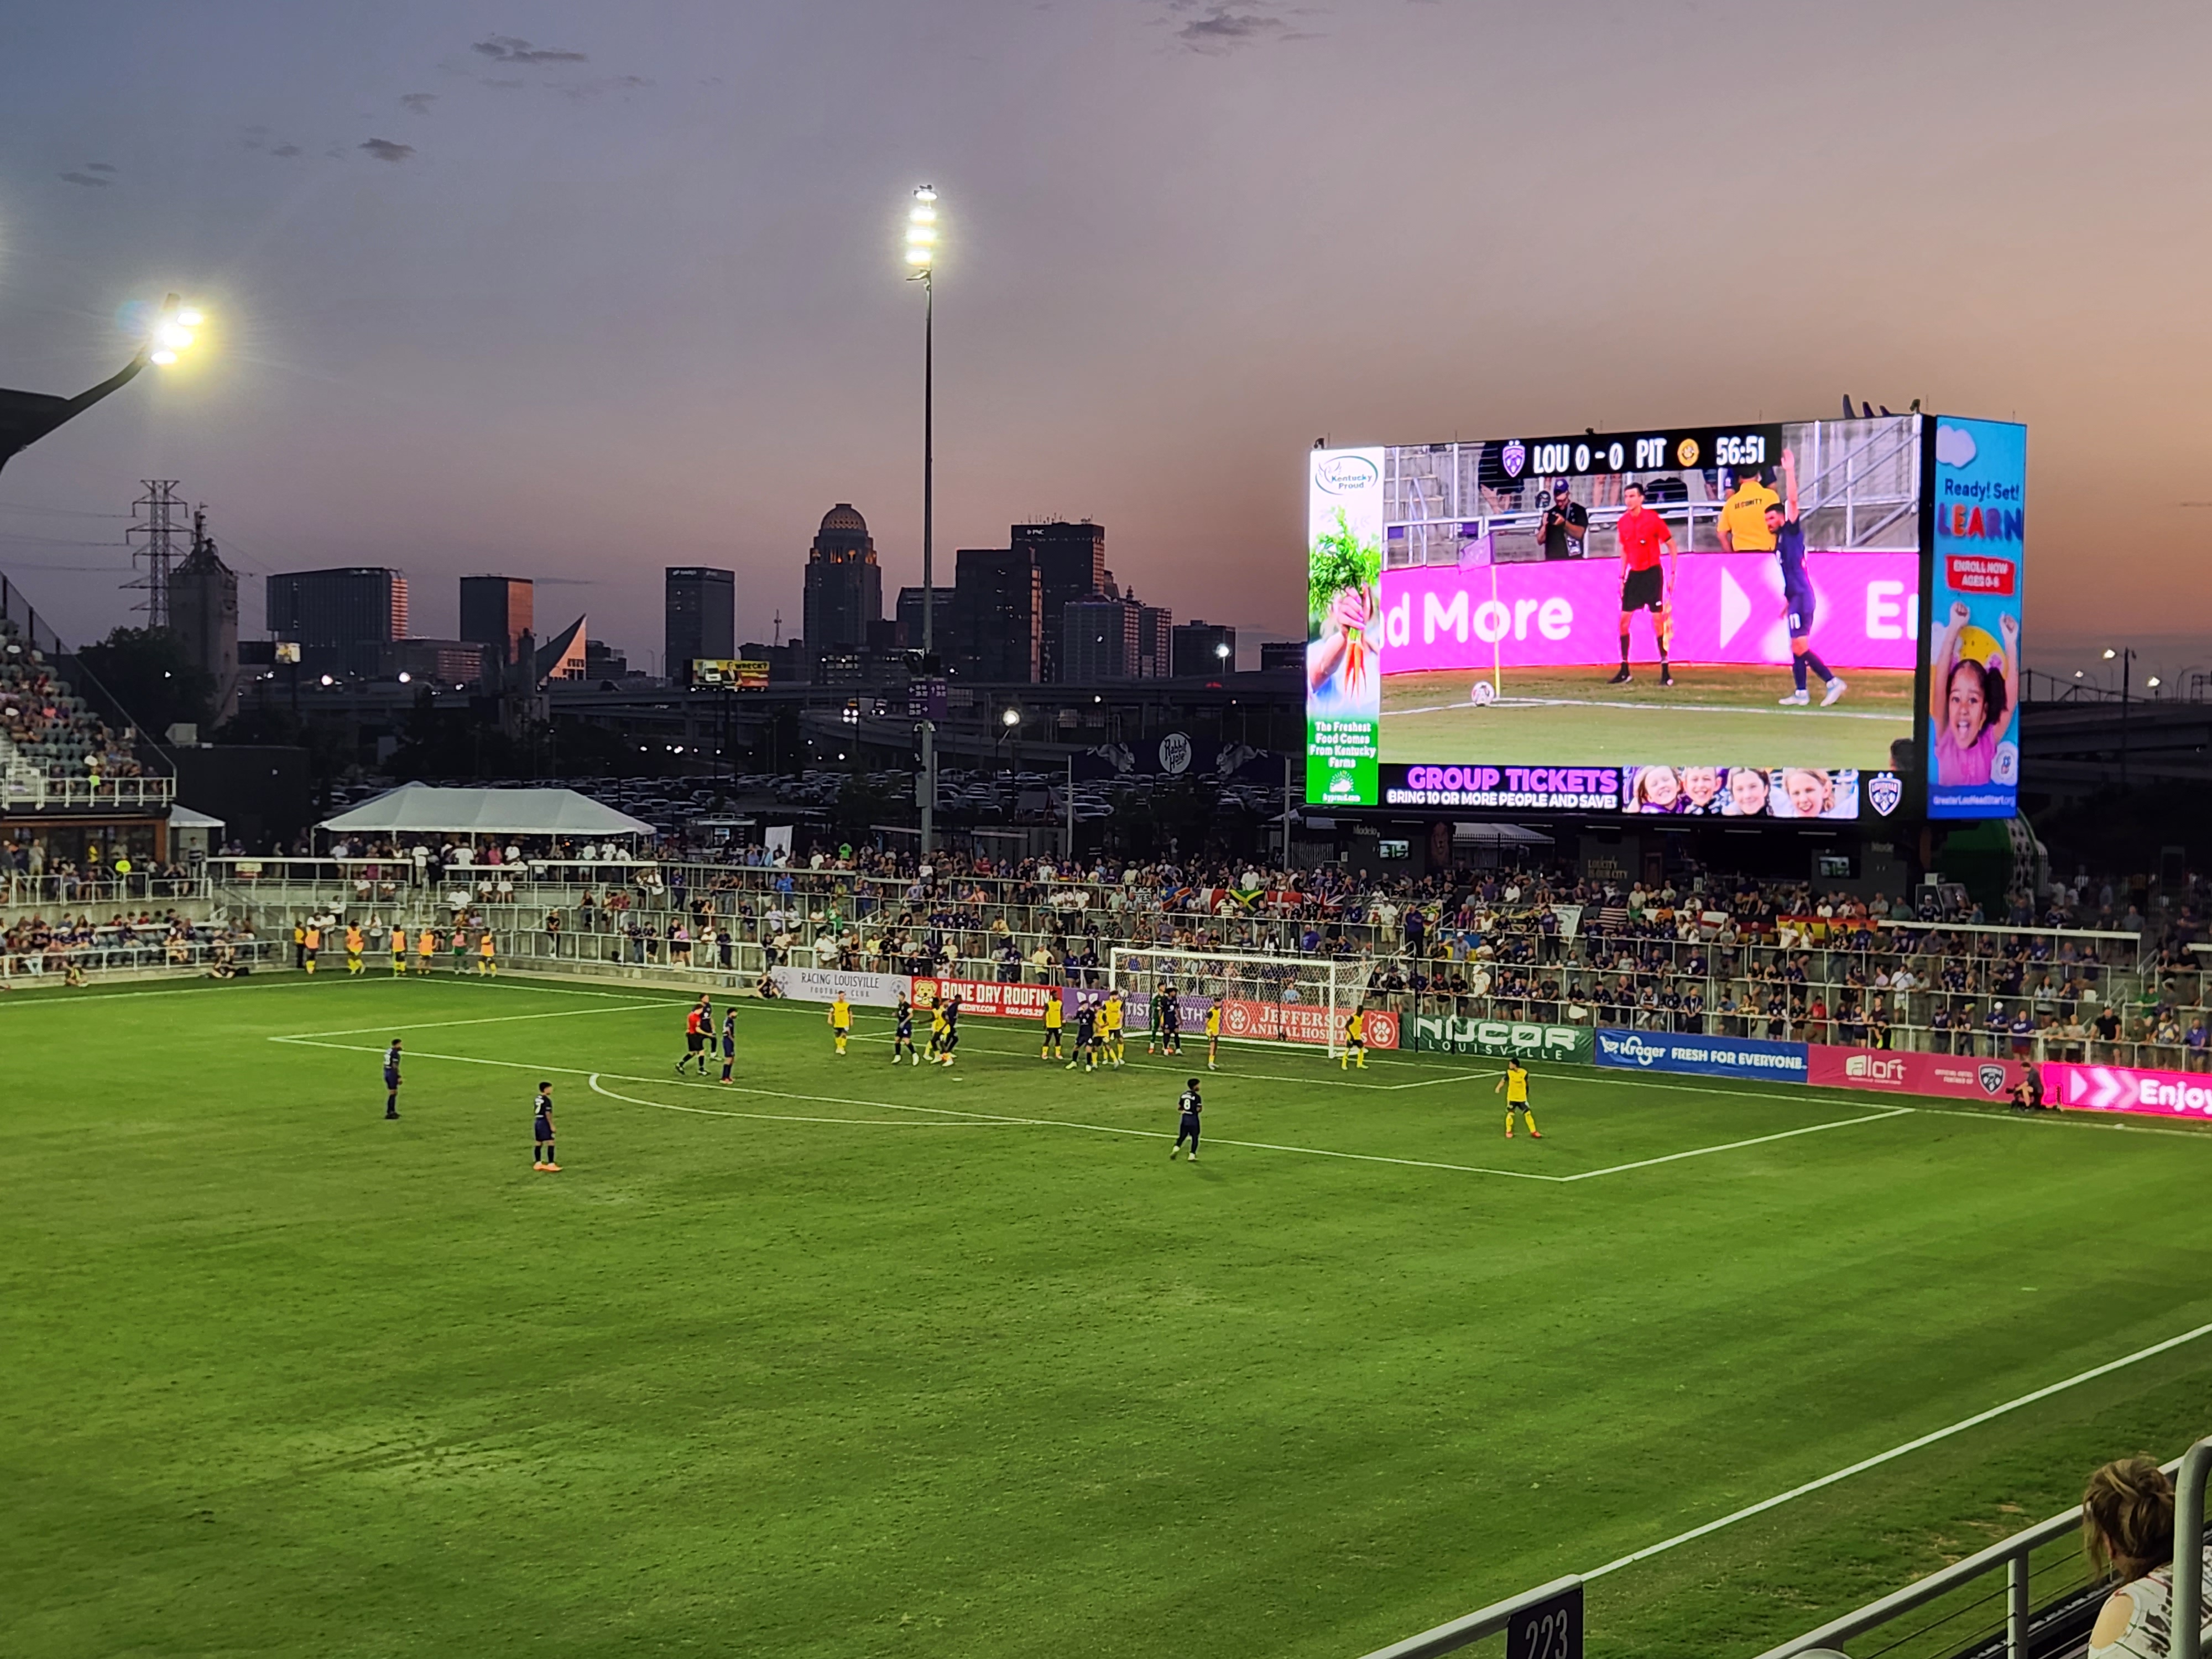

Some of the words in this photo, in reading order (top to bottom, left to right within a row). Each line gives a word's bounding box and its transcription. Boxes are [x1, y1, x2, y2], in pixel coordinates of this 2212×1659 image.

[1533, 444, 1570, 473] LOU
[1636, 437, 1667, 468] PIT
[1716, 436, 1765, 465] 56:51
[1332, 474, 1372, 482] Kentucky
[1944, 478, 1991, 502] Ready!
[1993, 482, 2020, 502] Set!
[1937, 502, 2023, 541] LEARN
[1424, 590, 1573, 644] More
[1315, 721, 1332, 732] The
[1333, 721, 1371, 732] Freshest
[1315, 733, 1338, 744] Food
[1340, 733, 1370, 744] Comes
[1164, 739, 1187, 761] Rabbit
[1310, 744, 1333, 755] From
[1334, 745, 1376, 759] Kentucky
[1170, 753, 1185, 772] Hole
[1328, 757, 1356, 768] Farms
[1407, 767, 1500, 790] GROUP
[1505, 769, 1618, 793] TICKETS
[1387, 789, 1425, 804] BRING
[1426, 791, 1439, 804] 10
[1441, 791, 1459, 805] OR
[1461, 792, 1498, 806] MORE
[1499, 792, 1548, 807] PEOPLE
[1549, 794, 1578, 808] AND
[1579, 794, 1618, 809] SAVE!
[801, 972, 831, 985] RACING
[834, 974, 879, 989] LOUISVILLE
[941, 982, 975, 1001] BONE
[977, 984, 1001, 1004] DRY
[1004, 985, 1053, 1006] ROOFIN
[1125, 1003, 1151, 1017] TIST
[1260, 1006, 1348, 1029] JEFFERSO
[1413, 1017, 1576, 1051] NUCOR
[1428, 1040, 1563, 1060] LOUISVILLE
[1620, 1036, 1666, 1066] Kroger
[1671, 1047, 1708, 1062] FRESH
[1711, 1050, 1736, 1065] FOR
[1739, 1052, 1807, 1070] EVERYONE.
[1845, 1055, 1907, 1080] aloft
[1183, 1098, 1191, 1110] 8
[1525, 1609, 1568, 1659] 223
